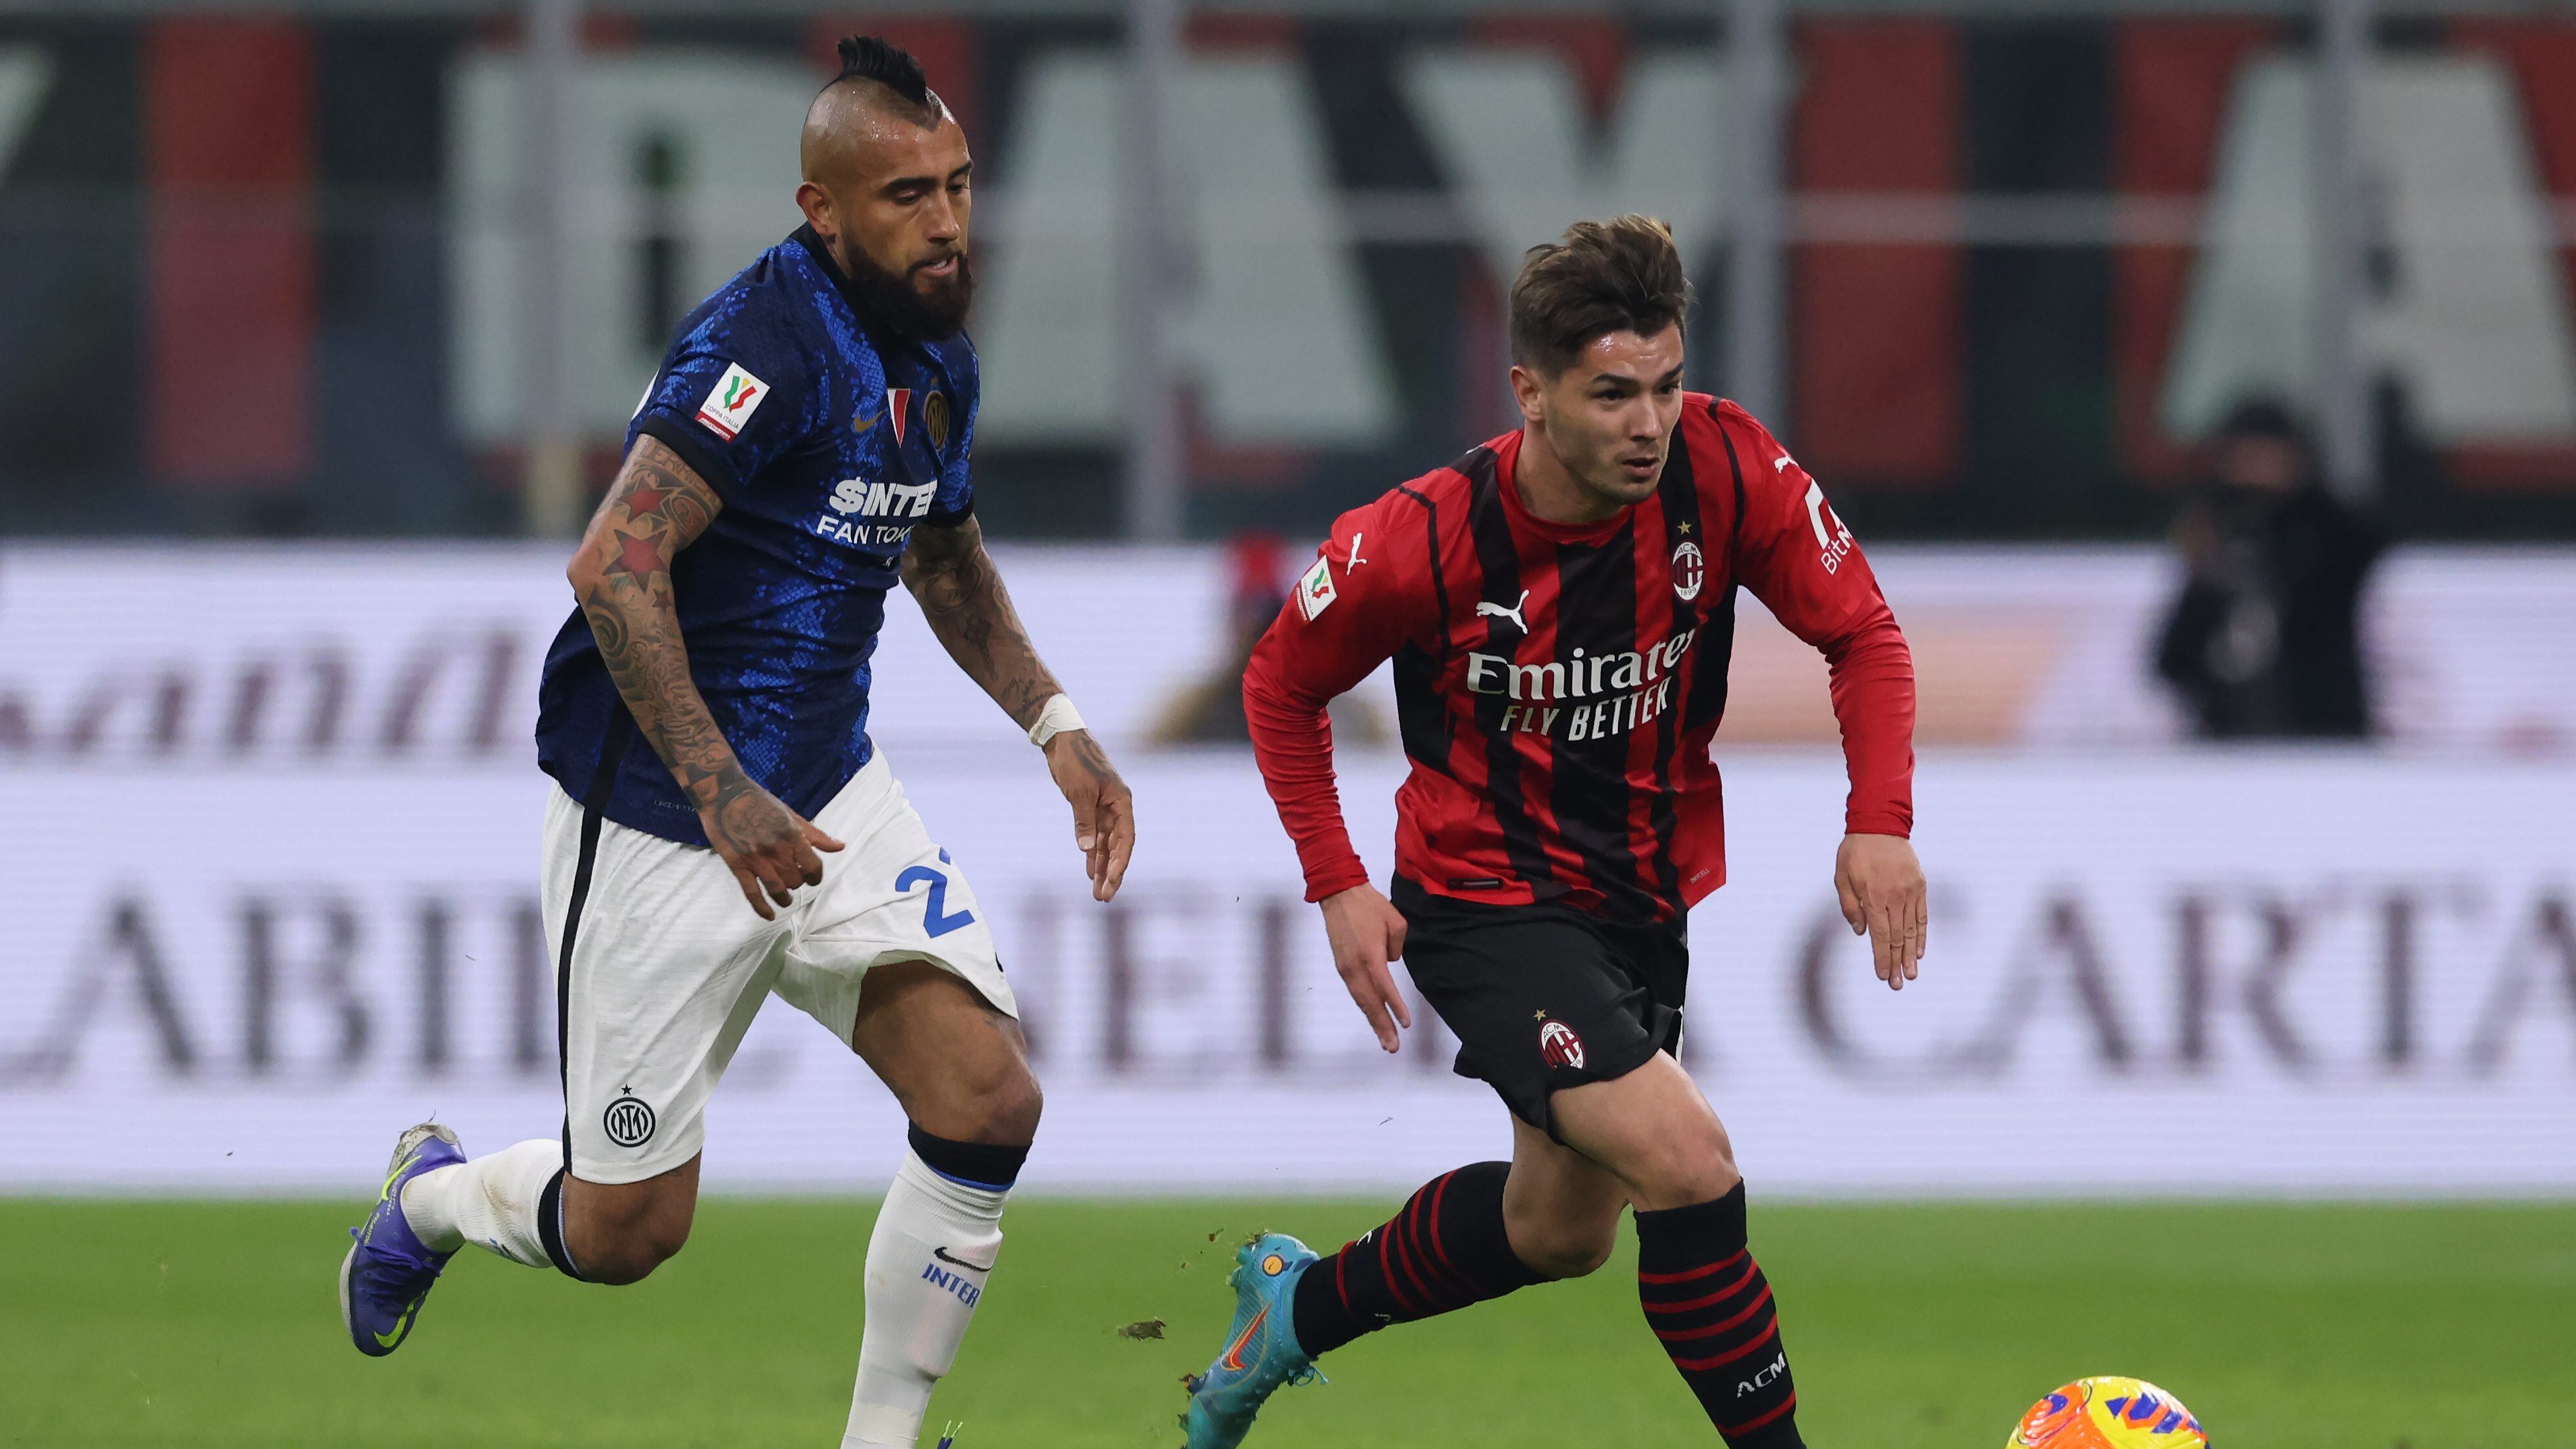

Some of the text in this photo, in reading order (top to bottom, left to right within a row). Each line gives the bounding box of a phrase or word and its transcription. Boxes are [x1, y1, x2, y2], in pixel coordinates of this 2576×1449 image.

[705, 404, 739, 430] COPPA ITALIA
[816, 514, 916, 545] FAN TOK
[1677, 543, 1698, 558] ACM
[1820, 521, 1853, 576] BitM
[1680, 587, 1697, 597] 1899
[1466, 627, 1696, 701] Emirates
[1500, 675, 1672, 742] FLY BETTER
[894, 847, 976, 939] 2
[1543, 1024, 1564, 1039] ACM
[921, 1263, 981, 1309] INTER
[1737, 1351, 1786, 1398] ACM
